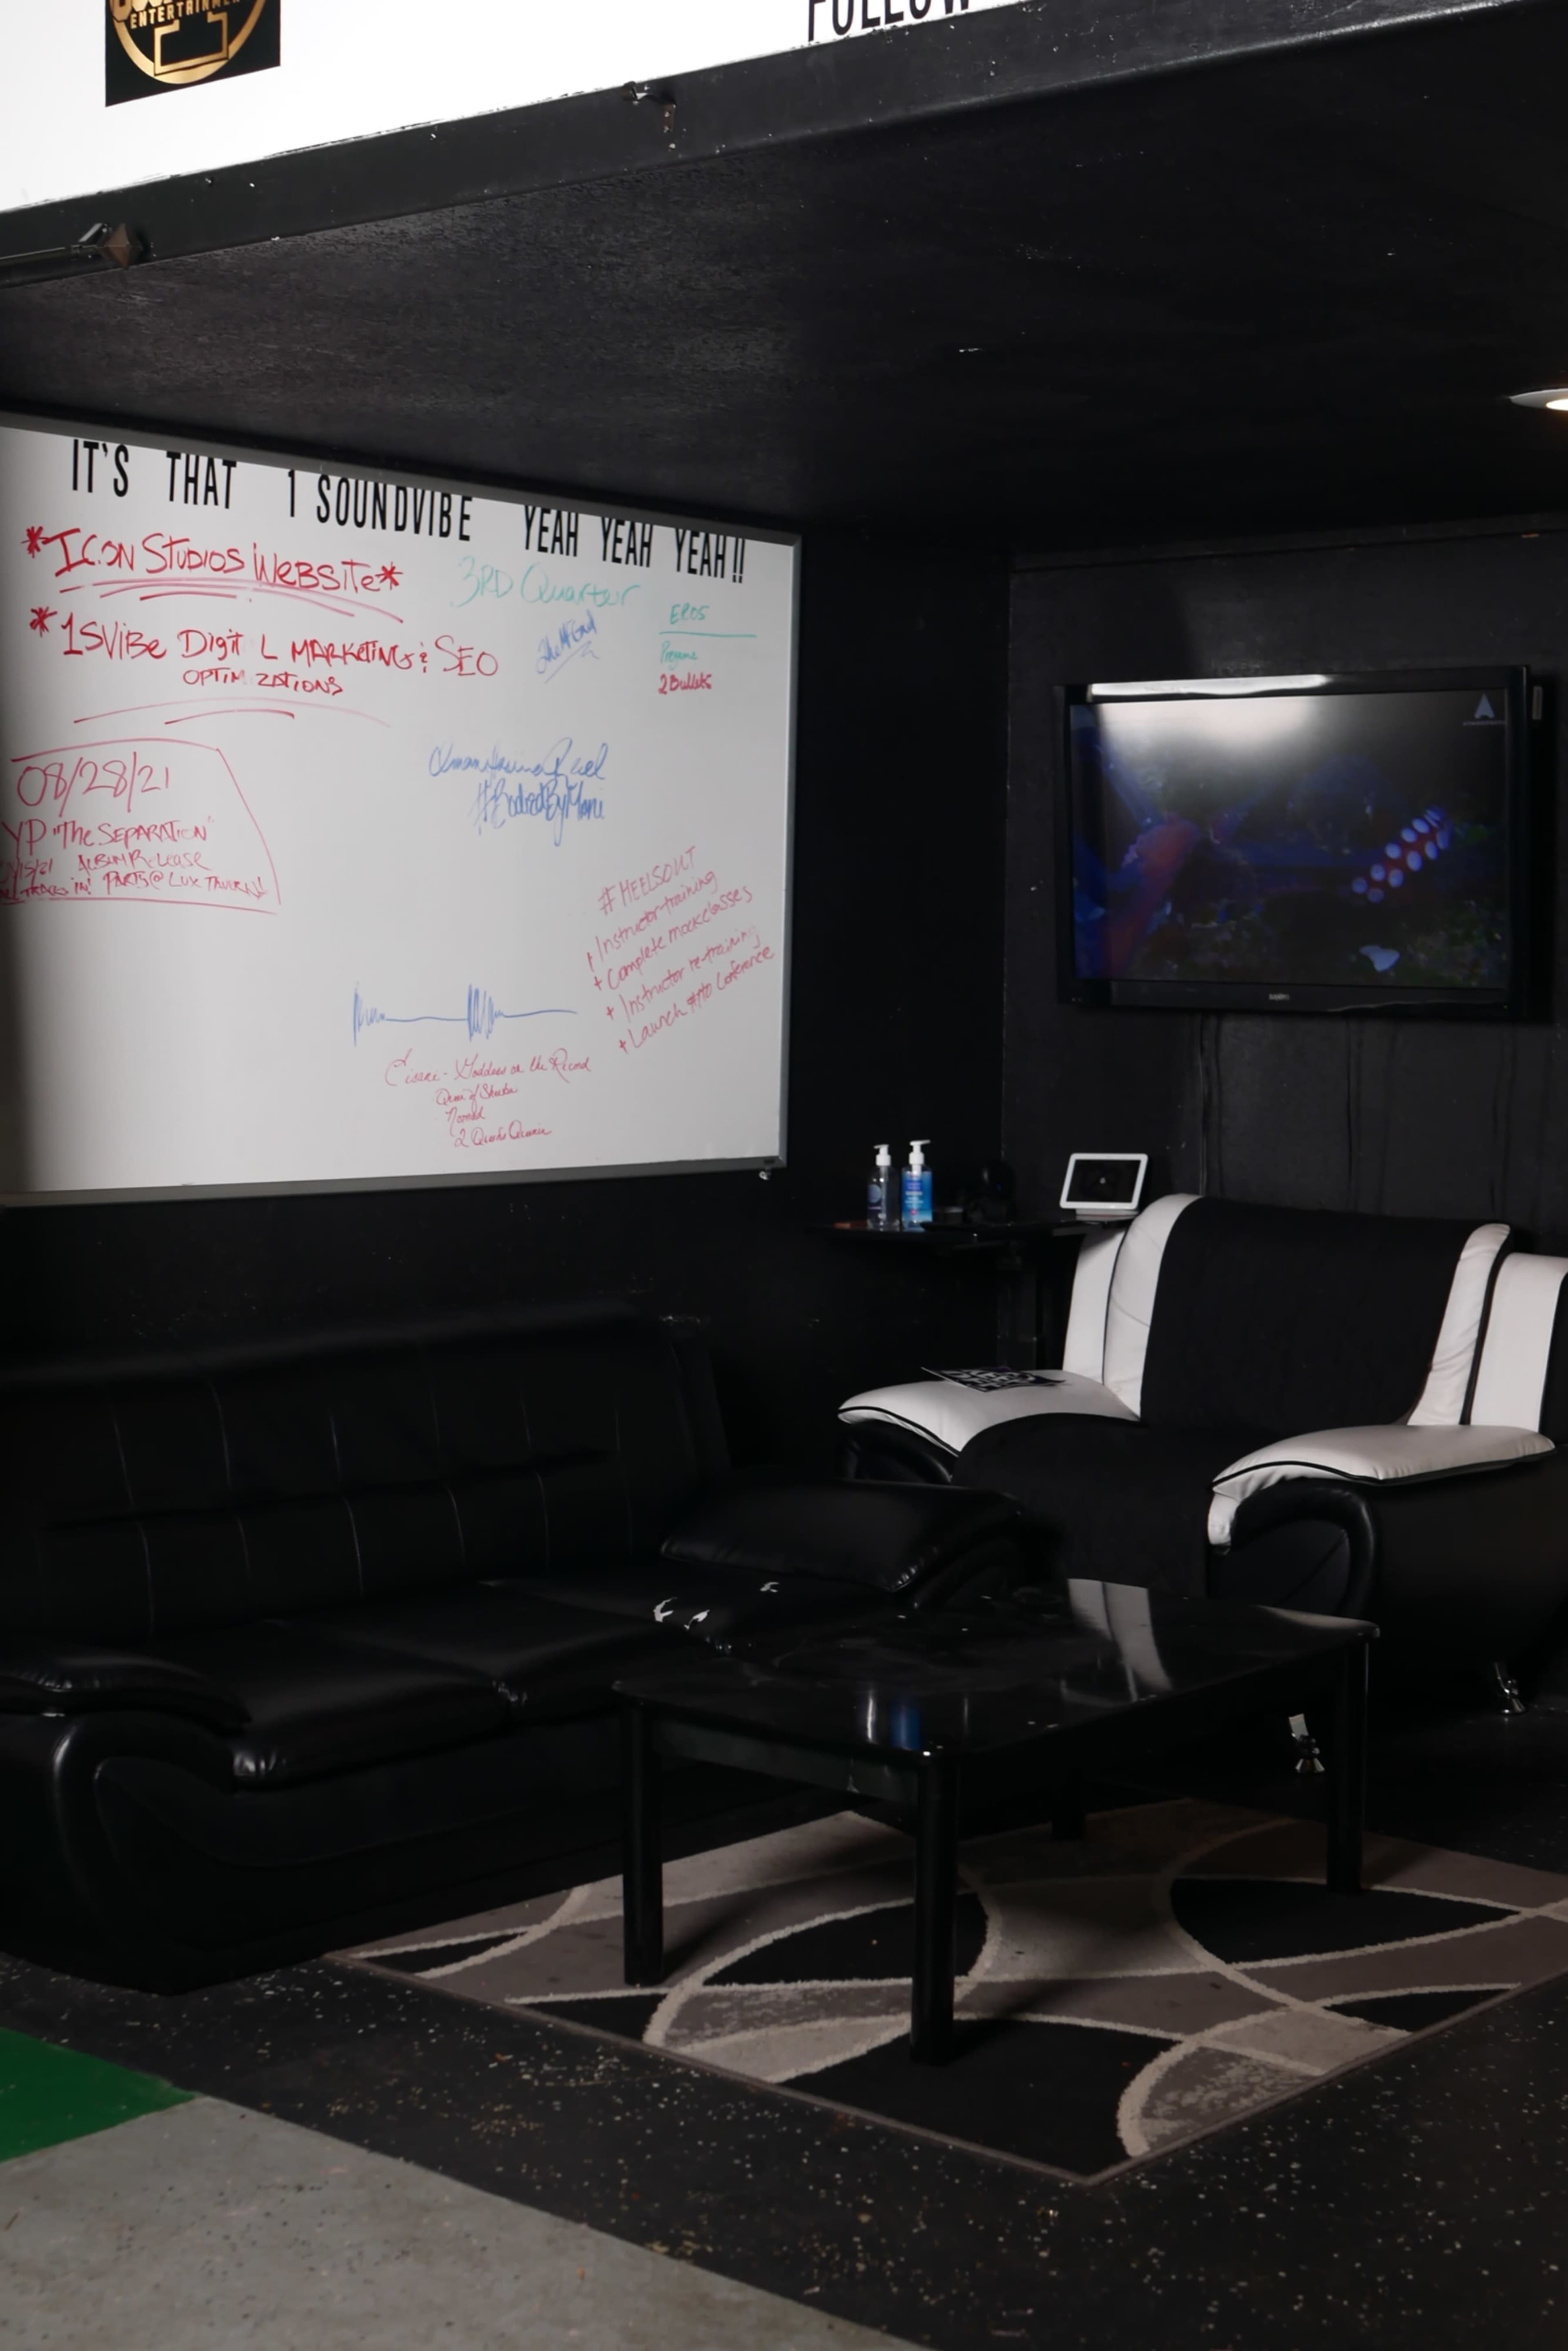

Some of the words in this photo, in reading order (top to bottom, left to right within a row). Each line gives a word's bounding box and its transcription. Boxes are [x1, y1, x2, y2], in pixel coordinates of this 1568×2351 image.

[72, 439, 129, 497] IT'S
[166, 451, 237, 509] THAT
[288, 470, 295, 517] 1
[316, 474, 473, 541] SOUNDVIBE
[524, 505, 579, 557] YEAH
[601, 517, 653, 567] YEAH
[434, 635, 498, 676] SEO
